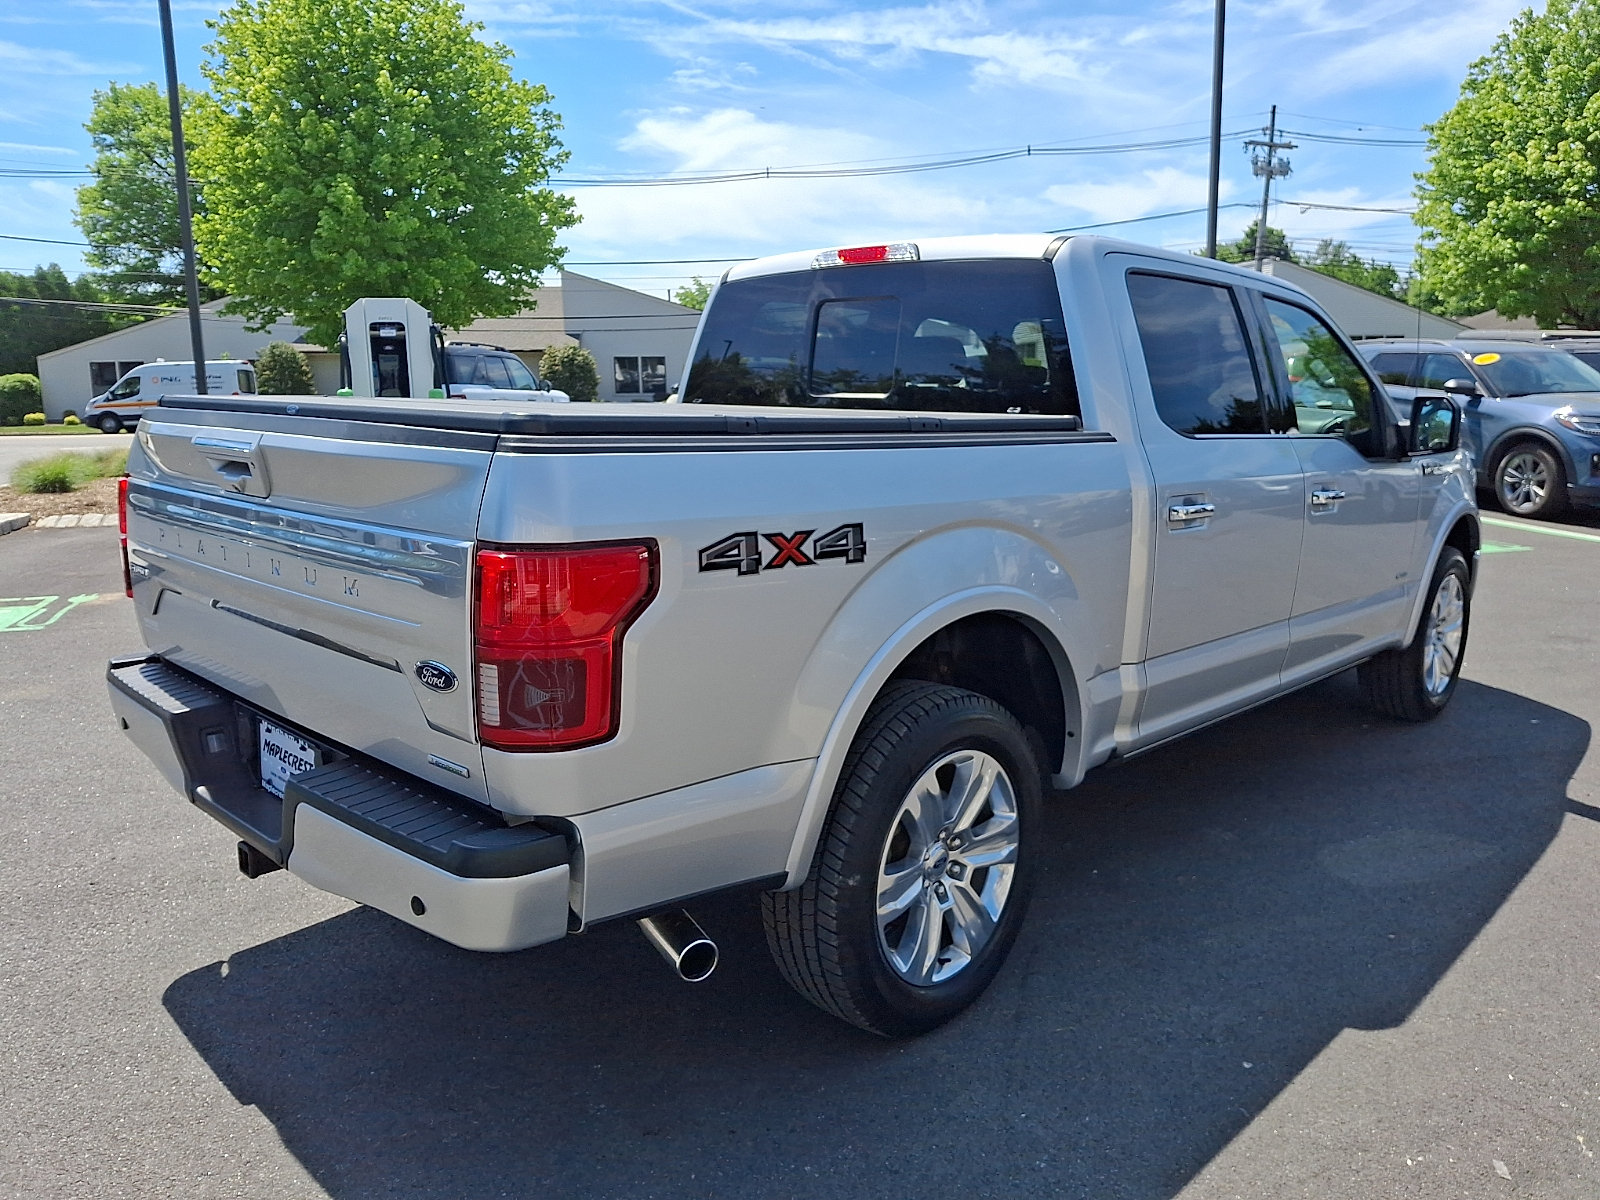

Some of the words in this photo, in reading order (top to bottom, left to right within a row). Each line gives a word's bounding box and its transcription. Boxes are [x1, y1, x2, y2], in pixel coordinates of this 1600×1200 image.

[158, 527, 360, 598] PLATINUM
[421, 666, 446, 688] Ford
[263, 738, 314, 773] MAPLECREST
